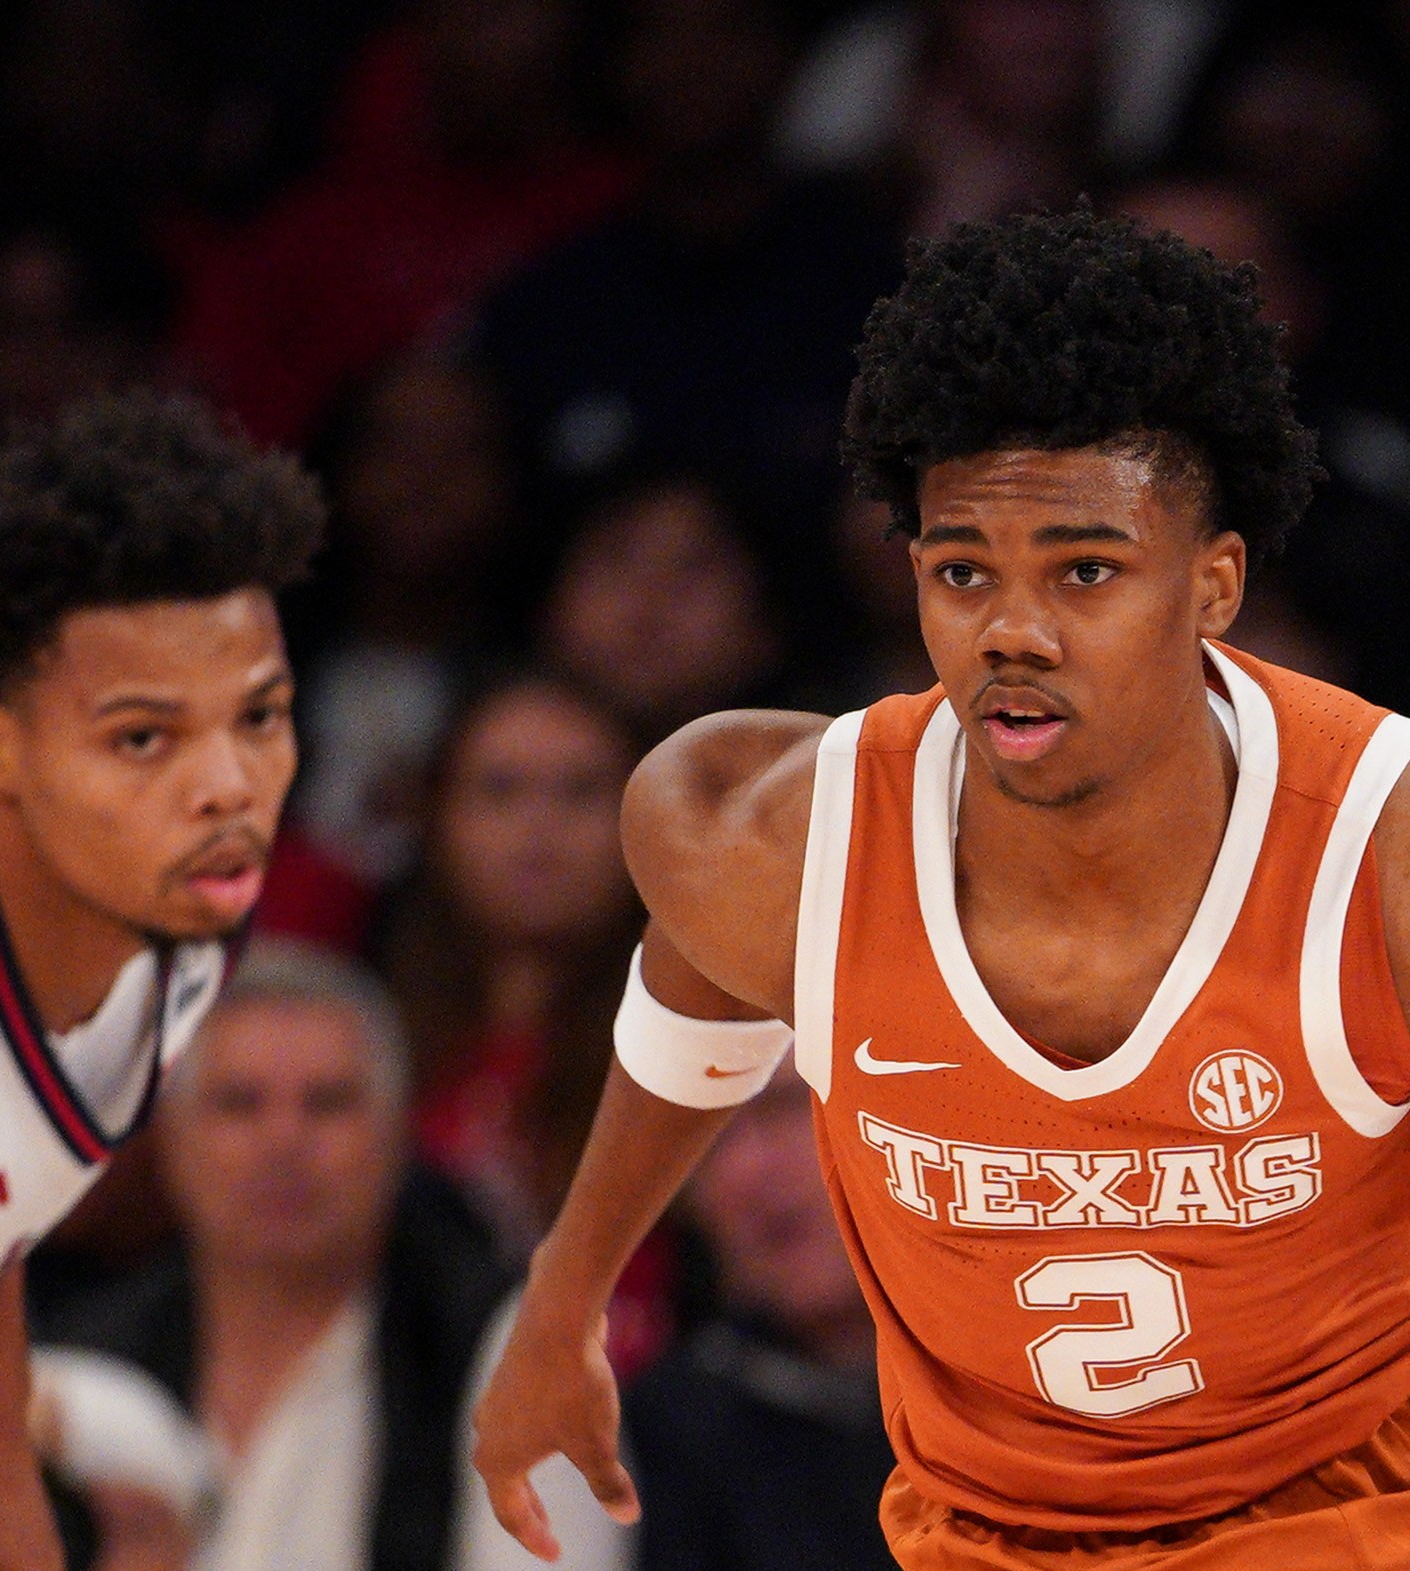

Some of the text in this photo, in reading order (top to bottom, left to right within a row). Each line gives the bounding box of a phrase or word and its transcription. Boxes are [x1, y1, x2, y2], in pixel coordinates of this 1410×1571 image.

[1196, 1056, 1275, 1128] SEC
[857, 1110, 1323, 1230] TEXAS
[1014, 1250, 1205, 1419] 2
